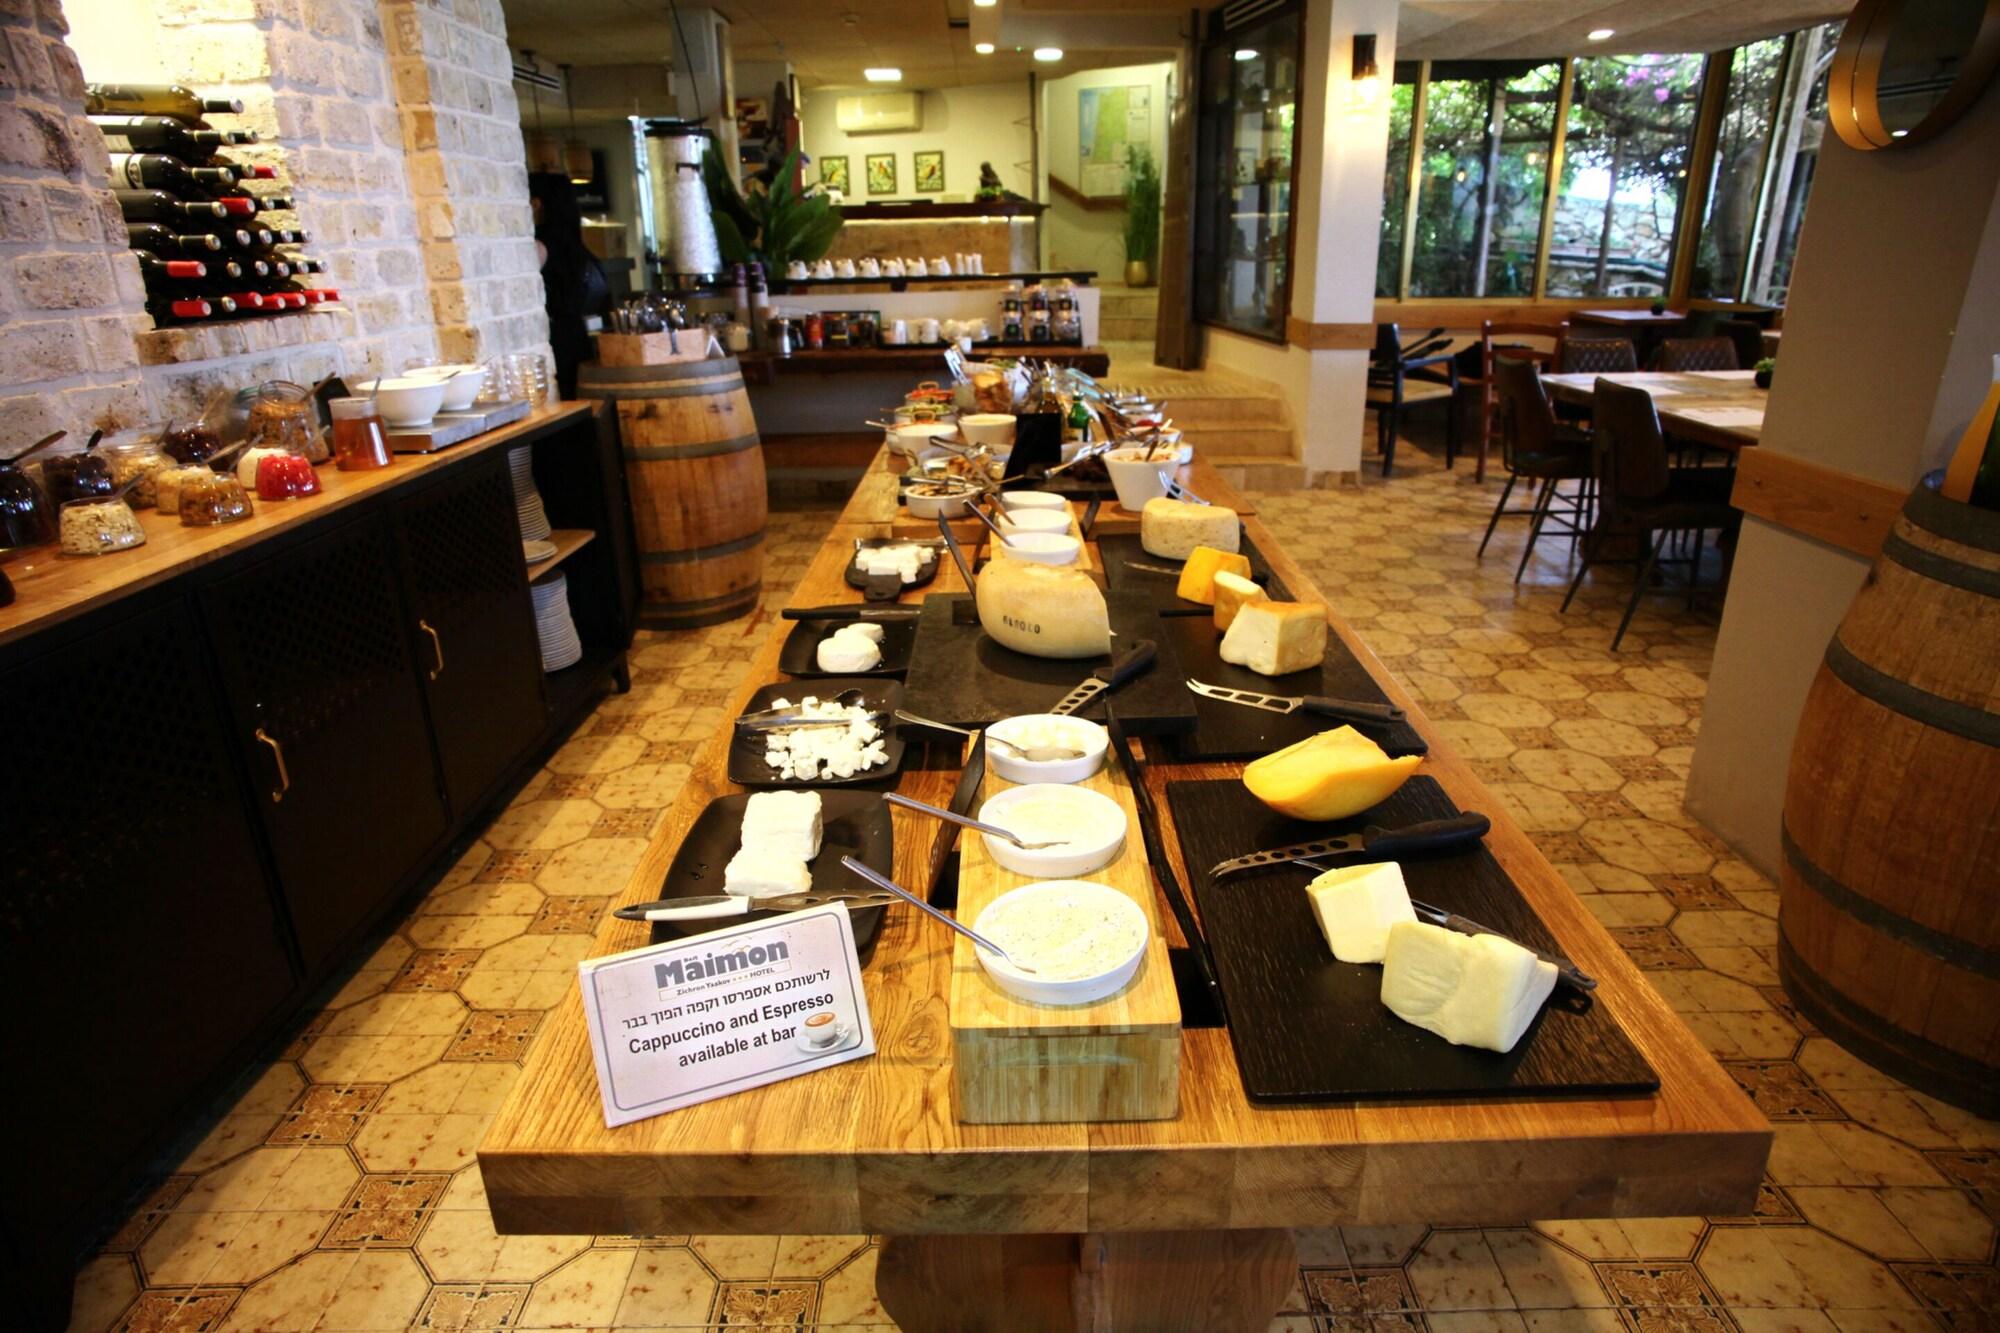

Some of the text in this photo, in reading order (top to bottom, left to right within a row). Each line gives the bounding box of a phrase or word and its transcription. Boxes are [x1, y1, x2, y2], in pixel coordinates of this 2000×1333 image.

[654, 939, 789, 988] Maimon
[676, 984, 706, 996] Zichron
[750, 967, 775, 978] HOTEL
[622, 968, 831, 1030] לרשותכם אספרסו וקפה הפוך בבר
[629, 993, 833, 1055] Cappuccino and Espresso
[679, 1025, 797, 1068] available at bar
